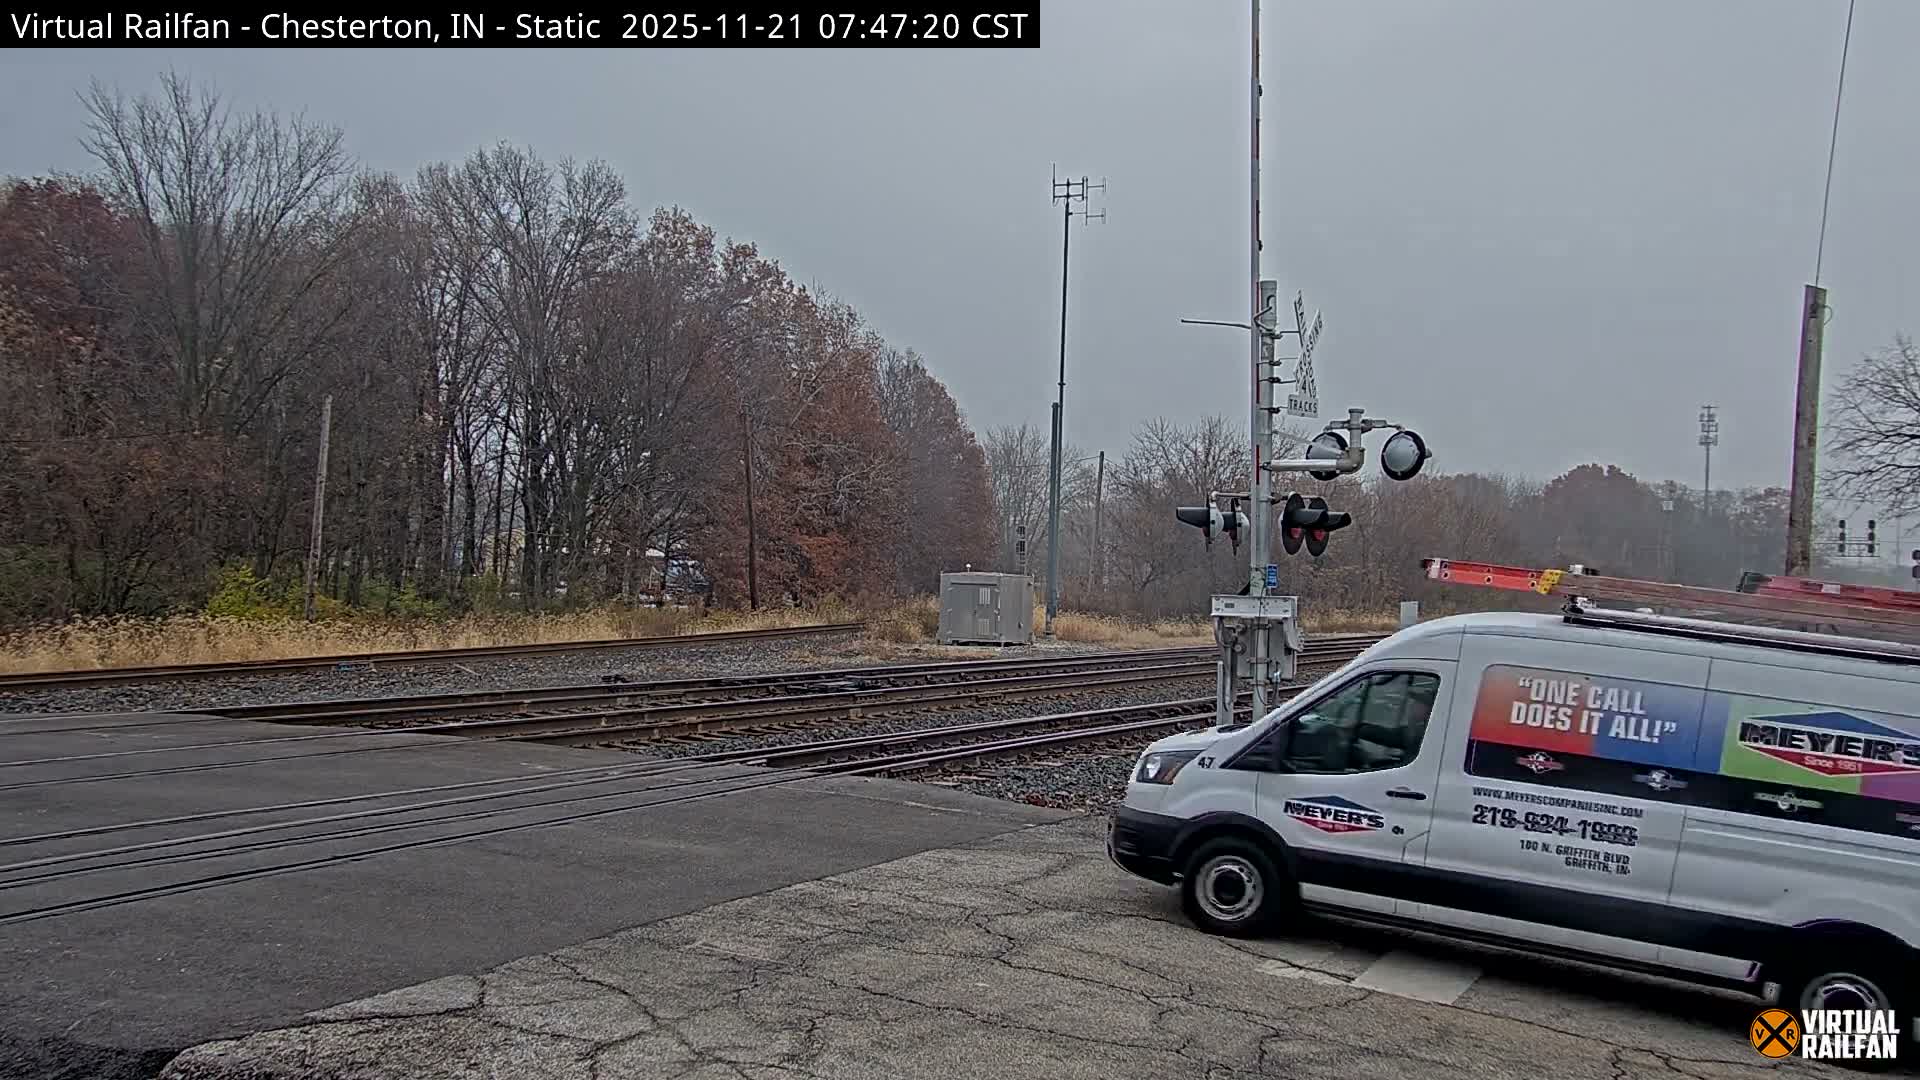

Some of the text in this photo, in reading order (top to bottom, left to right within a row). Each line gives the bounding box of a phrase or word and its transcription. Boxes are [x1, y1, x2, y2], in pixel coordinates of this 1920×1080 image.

[1288, 397, 1318, 414] TRACKS
[1587, 685, 1647, 715] CALL
[1510, 701, 1678, 744] DOES IT ALL!”
[1198, 756, 1217, 769] 47
[1804, 755, 1863, 773] Since 1951
[1283, 801, 1385, 829] MEYER'S
[1520, 839, 1538, 851] 100
[1556, 845, 1600, 861] GRIFFITH
[1603, 852, 1631, 865] BLVD
